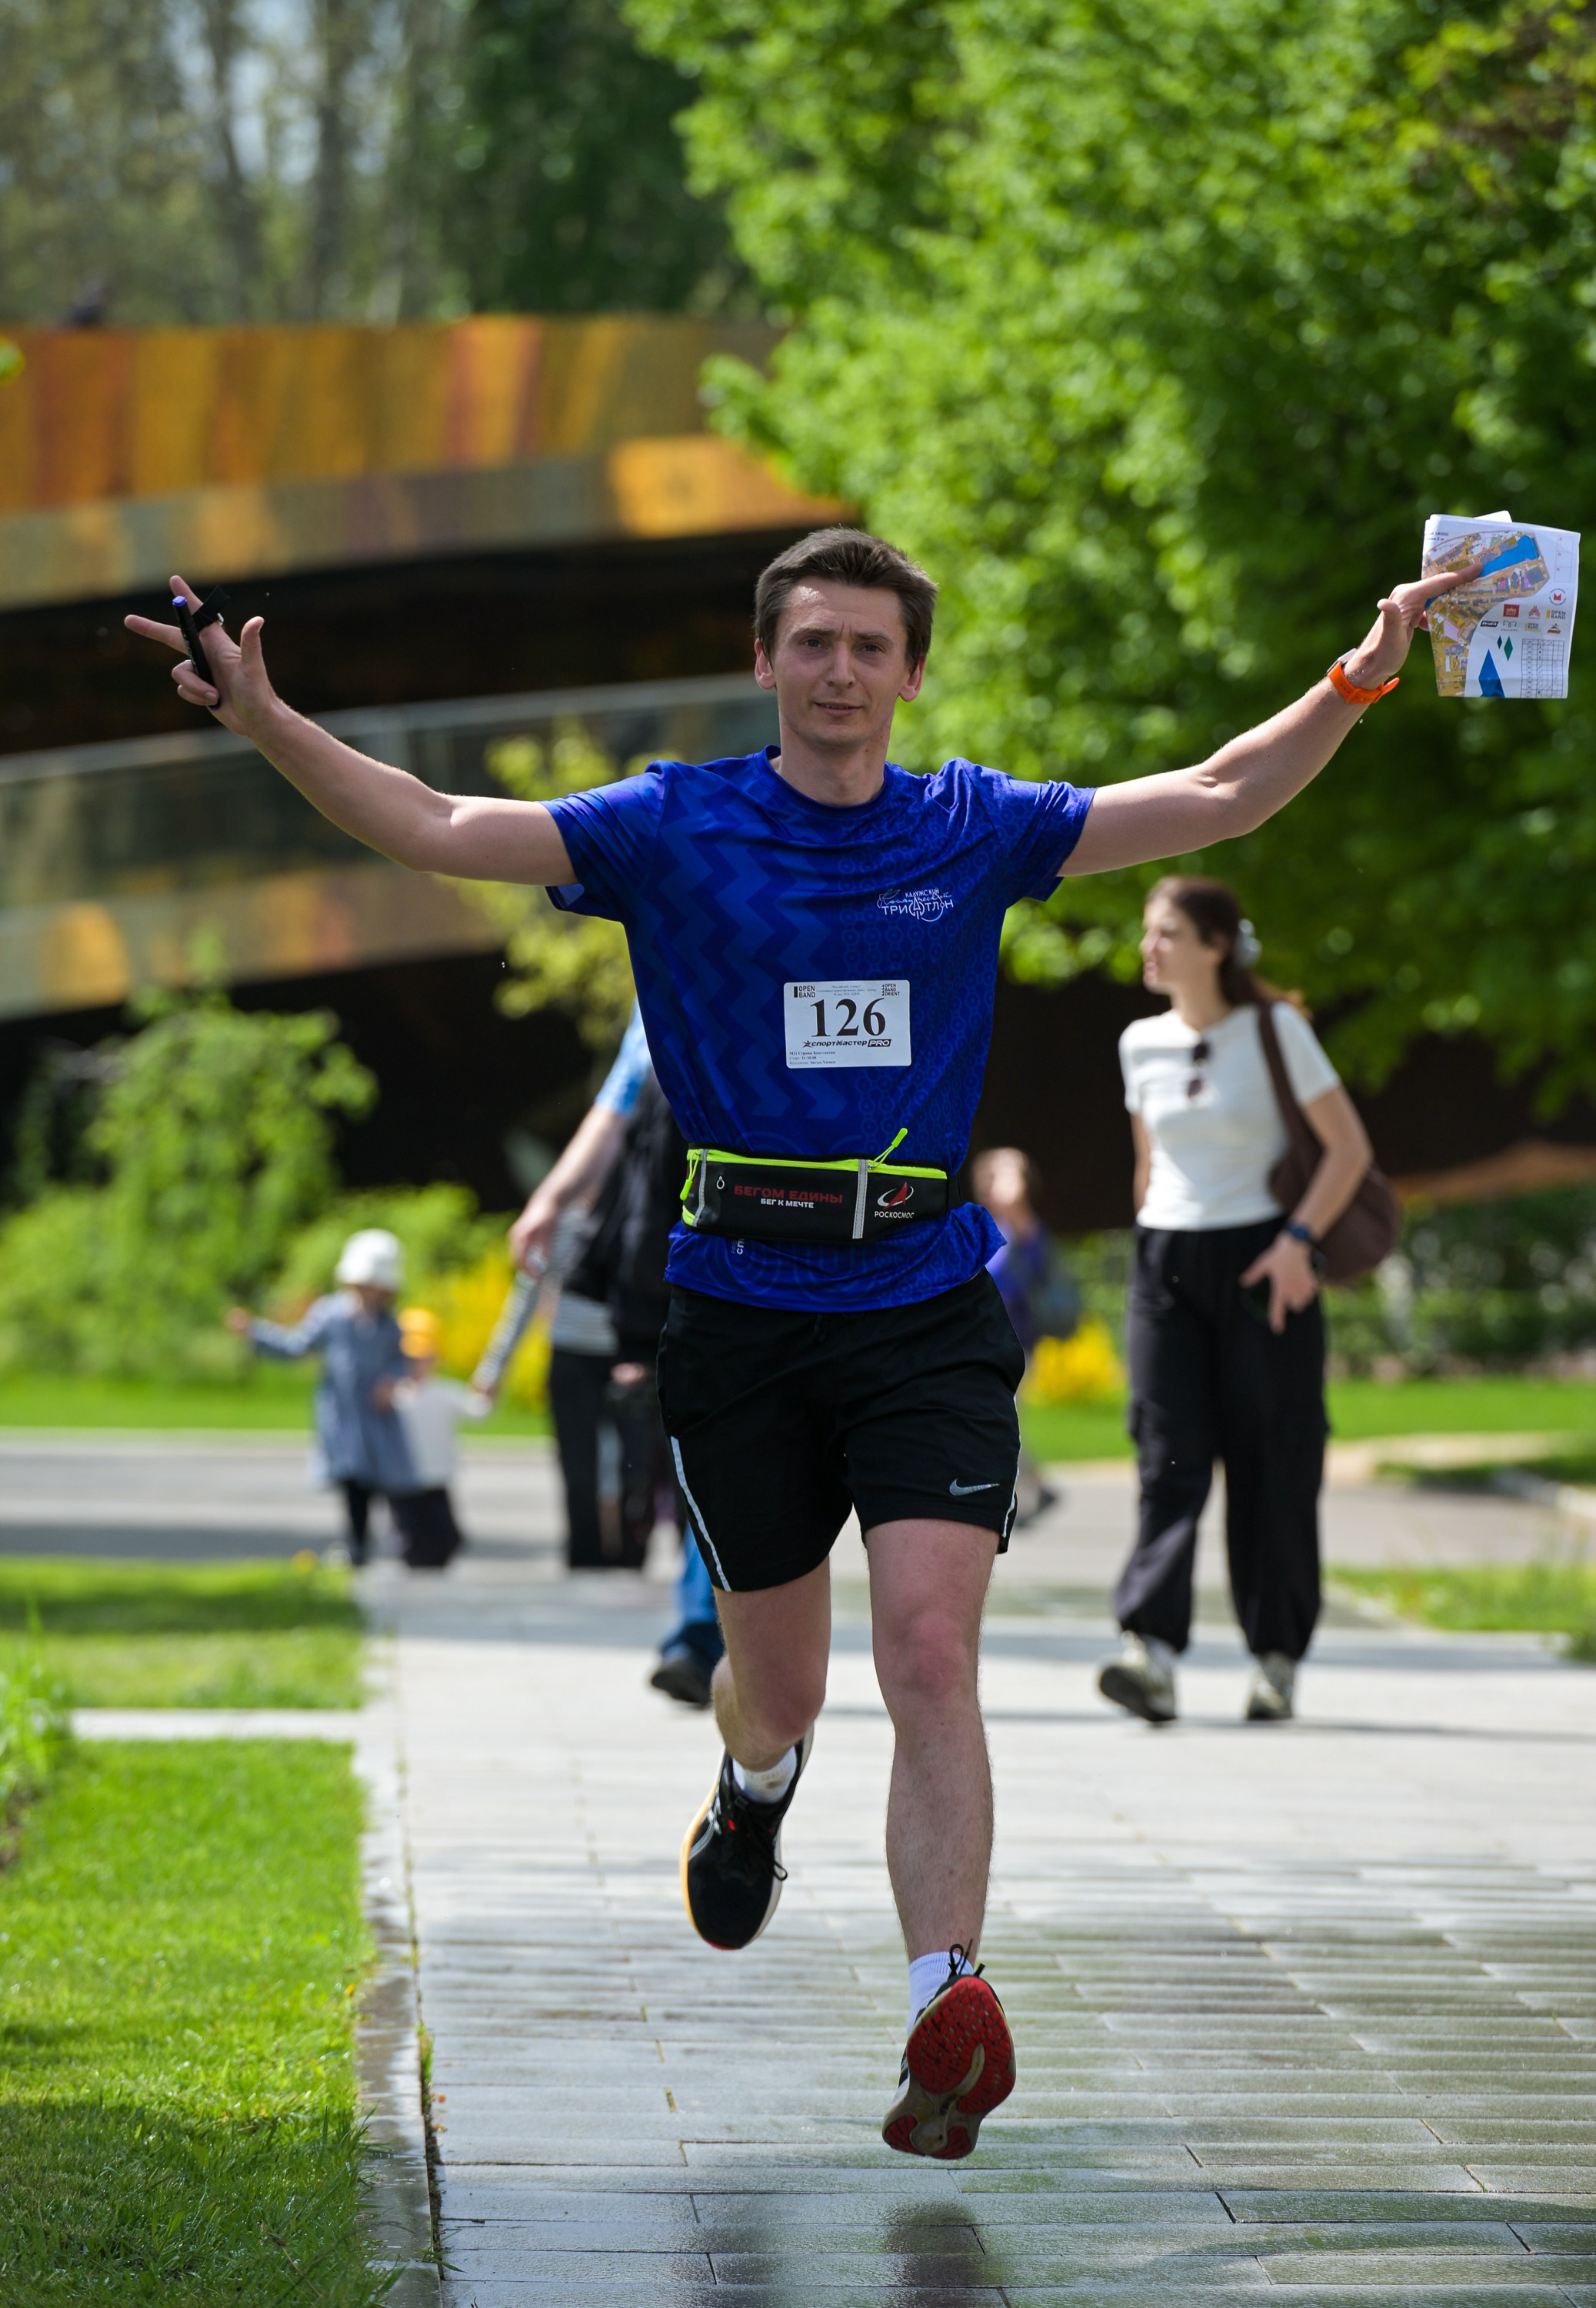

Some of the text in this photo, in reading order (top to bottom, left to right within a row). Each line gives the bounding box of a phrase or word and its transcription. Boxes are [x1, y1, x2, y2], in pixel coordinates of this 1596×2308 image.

[810, 998, 886, 1037] 126
[734, 1184, 843, 1205] БЕГОМ ЕДИНЫ
[785, 1200, 815, 1209] МЕЧТЕ
[875, 1211, 915, 1219] РОСКОСМОС
